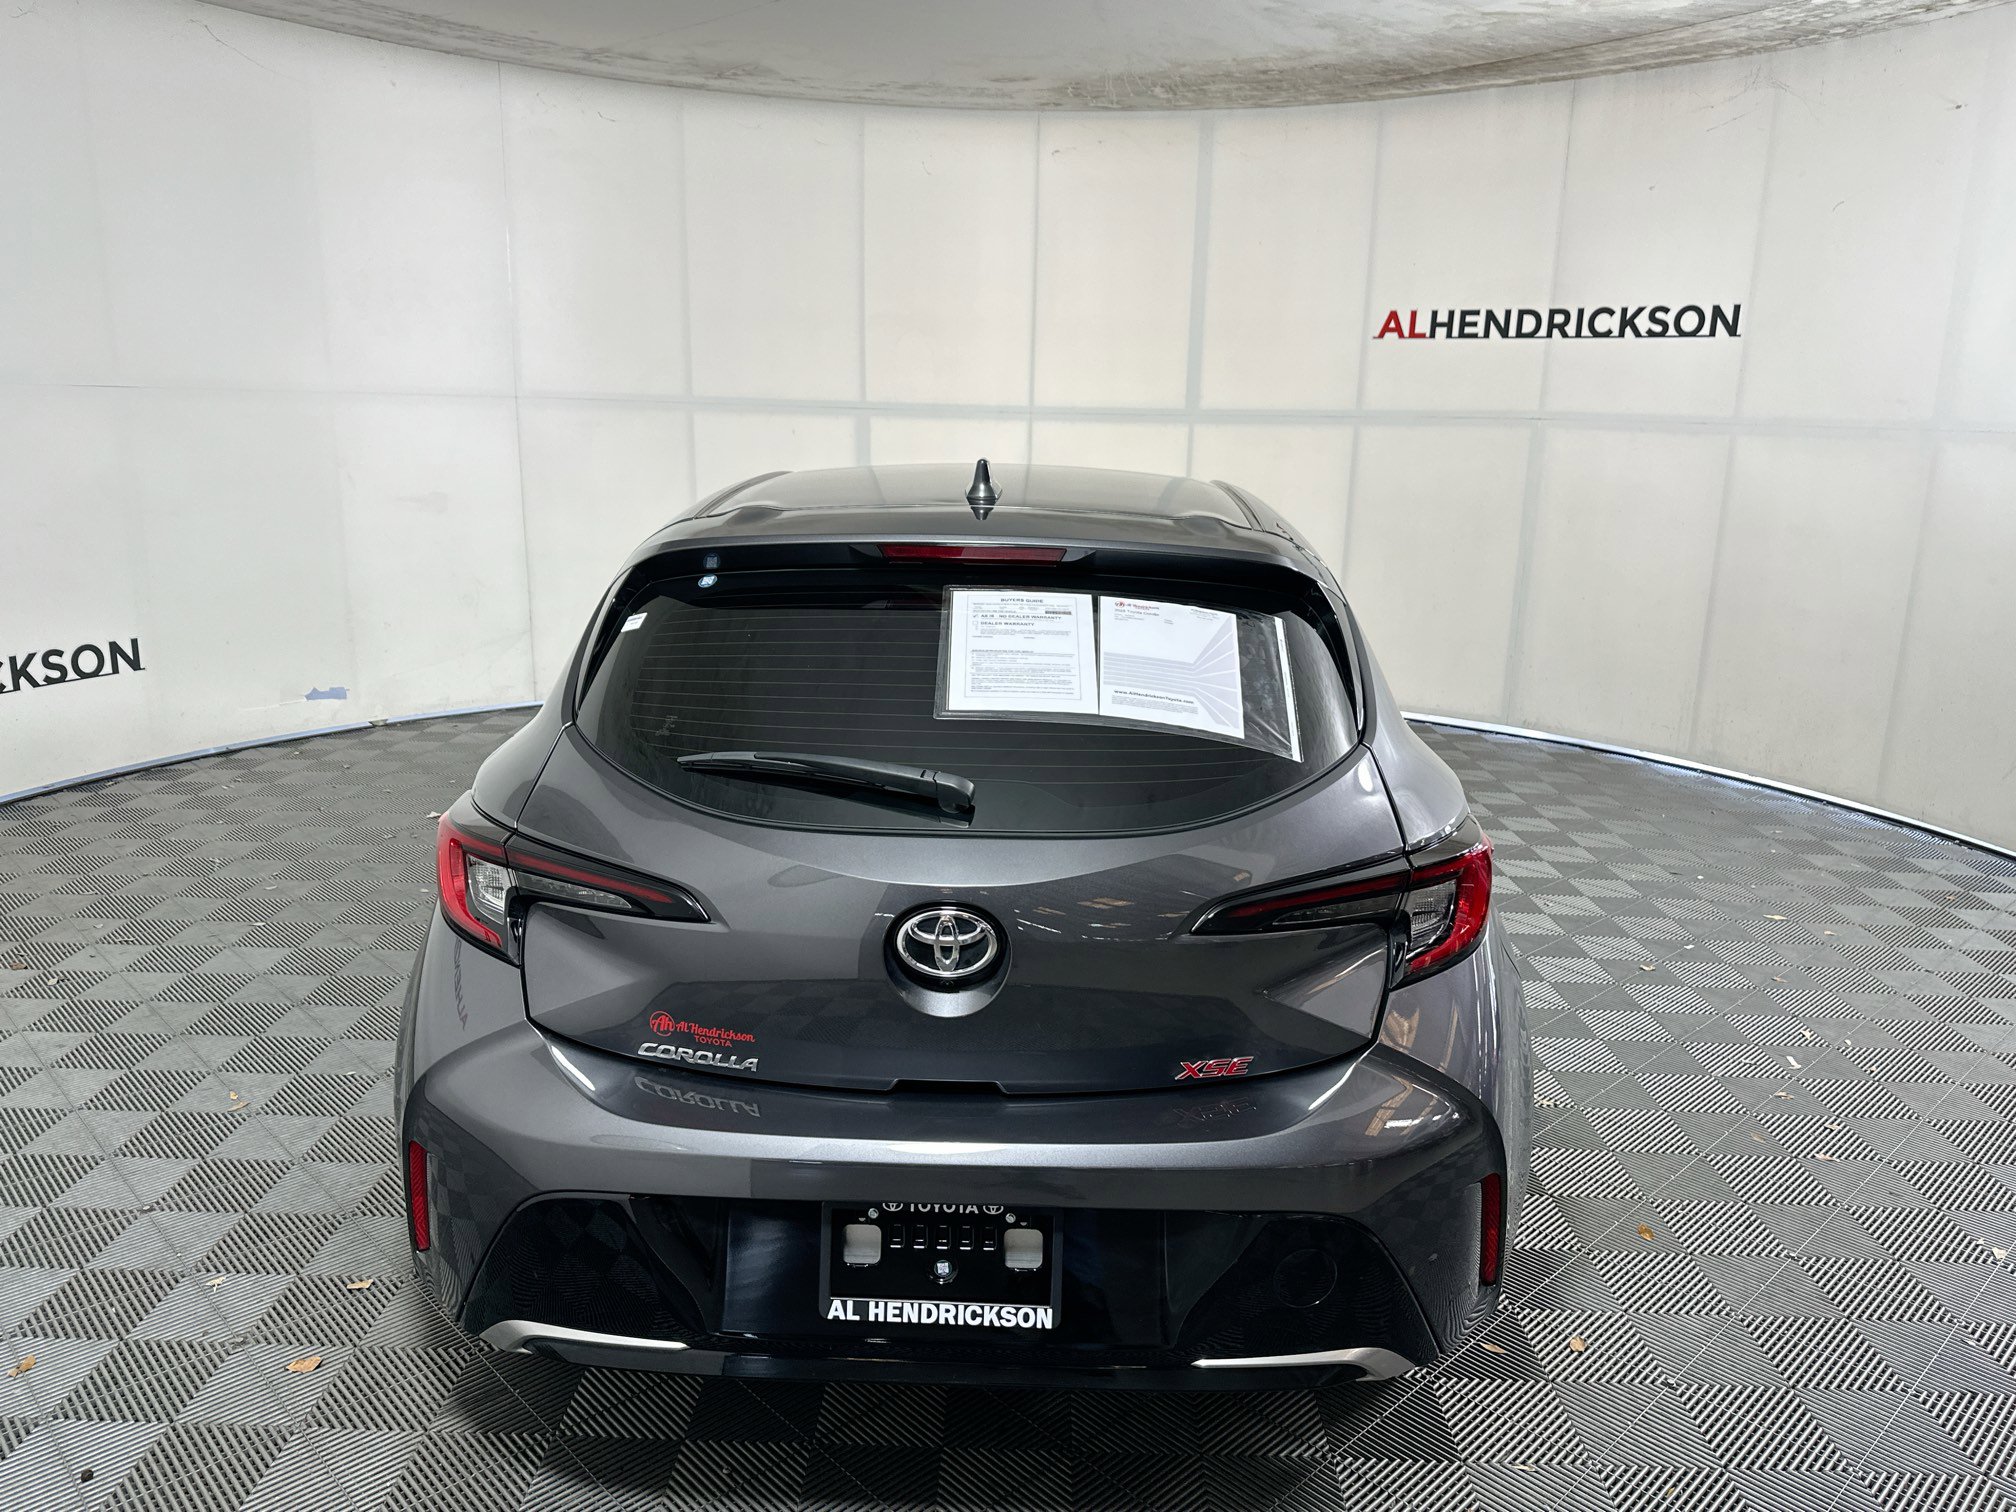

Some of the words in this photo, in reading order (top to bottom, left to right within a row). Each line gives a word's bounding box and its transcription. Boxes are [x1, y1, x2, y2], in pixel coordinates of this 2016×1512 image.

[1375, 303, 1741, 339] ALHENDRICKSON
[689, 1022, 756, 1043] Hendrickson
[694, 1035, 733, 1048] TOYOTA
[637, 1042, 759, 1072] COROLLA
[1174, 1056, 1254, 1080] XSE
[827, 1299, 861, 1321] AL
[868, 1300, 1053, 1329] HENDRICKSON
